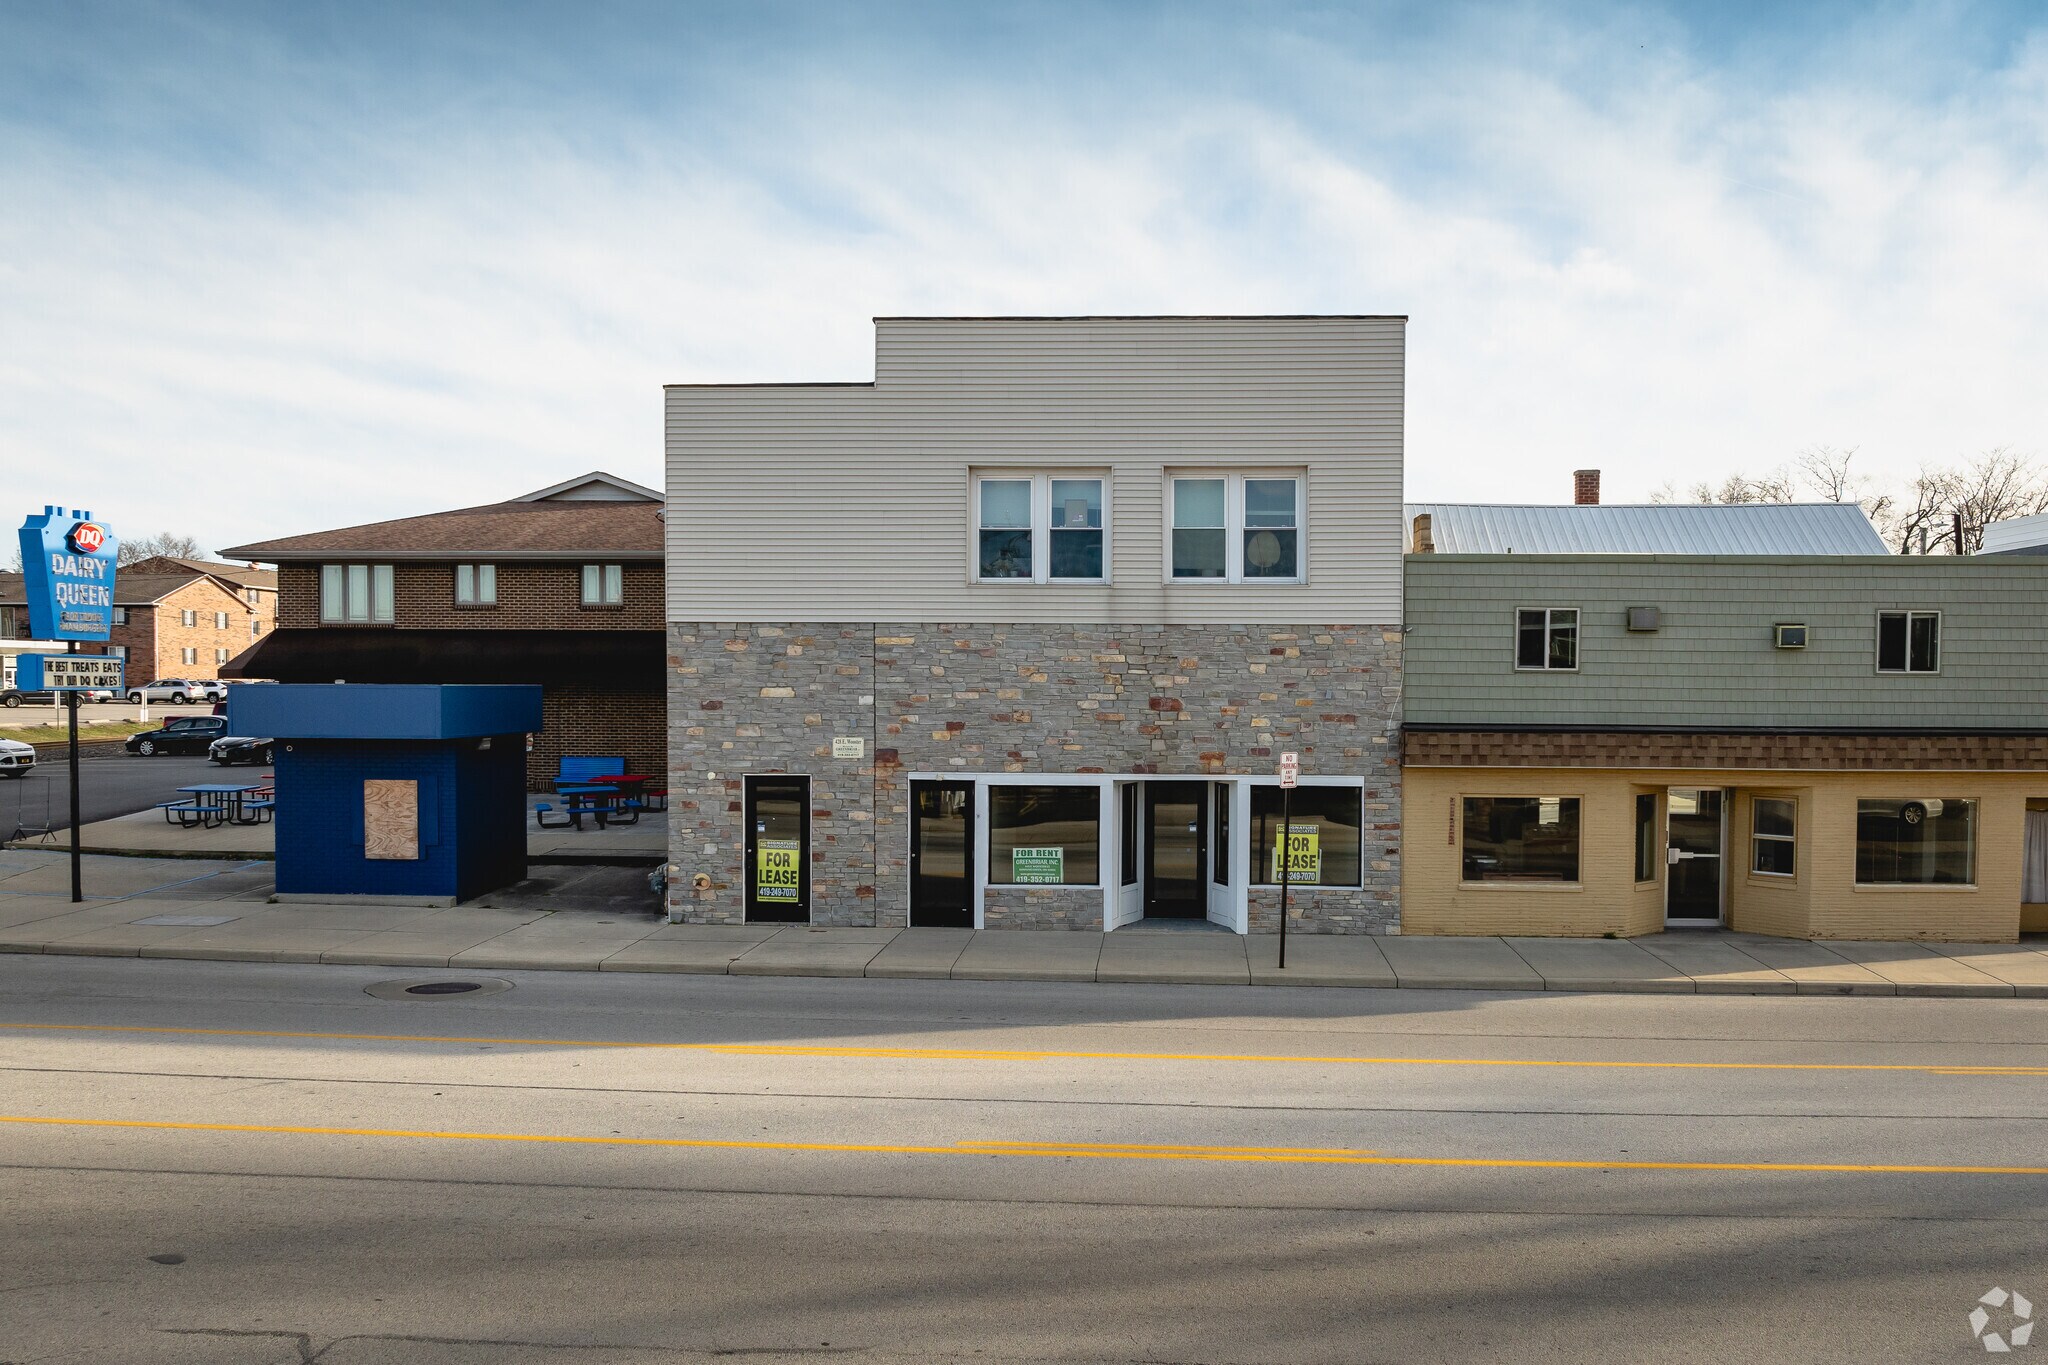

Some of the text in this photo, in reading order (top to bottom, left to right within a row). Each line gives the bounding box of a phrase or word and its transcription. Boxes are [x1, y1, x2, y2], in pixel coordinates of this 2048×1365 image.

[79, 528, 101, 547] DQ
[52, 553, 108, 579] DAIRY
[56, 582, 110, 608] QUEEN
[44, 661, 122, 673] THE BEST TREATS EATS
[80, 675, 91, 686] DQ
[766, 852, 790, 867] FOR
[759, 869, 798, 884] LEASE
[760, 887, 797, 896] 419-249-7070
